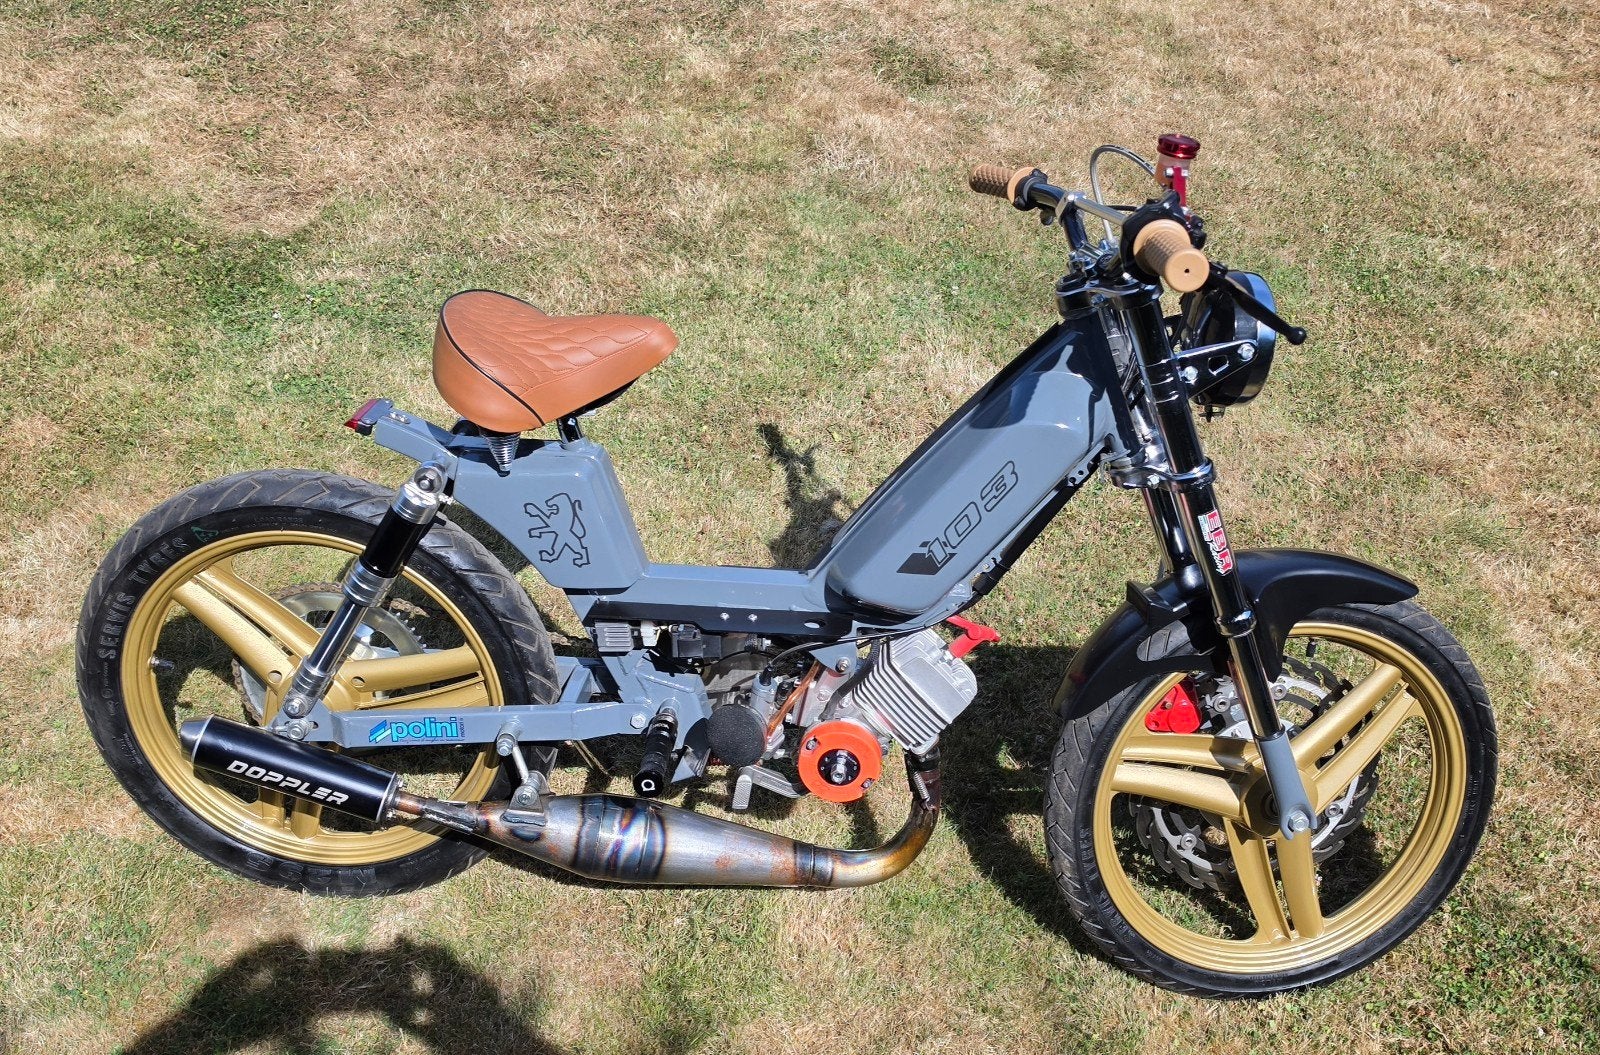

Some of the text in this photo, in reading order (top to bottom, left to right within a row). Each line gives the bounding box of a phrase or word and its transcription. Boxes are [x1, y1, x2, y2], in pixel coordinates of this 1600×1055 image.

[927, 461, 1019, 565] 103
[1206, 510, 1233, 573] EBR
[390, 717, 458, 742] polini
[226, 759, 350, 805] DOPPLER
